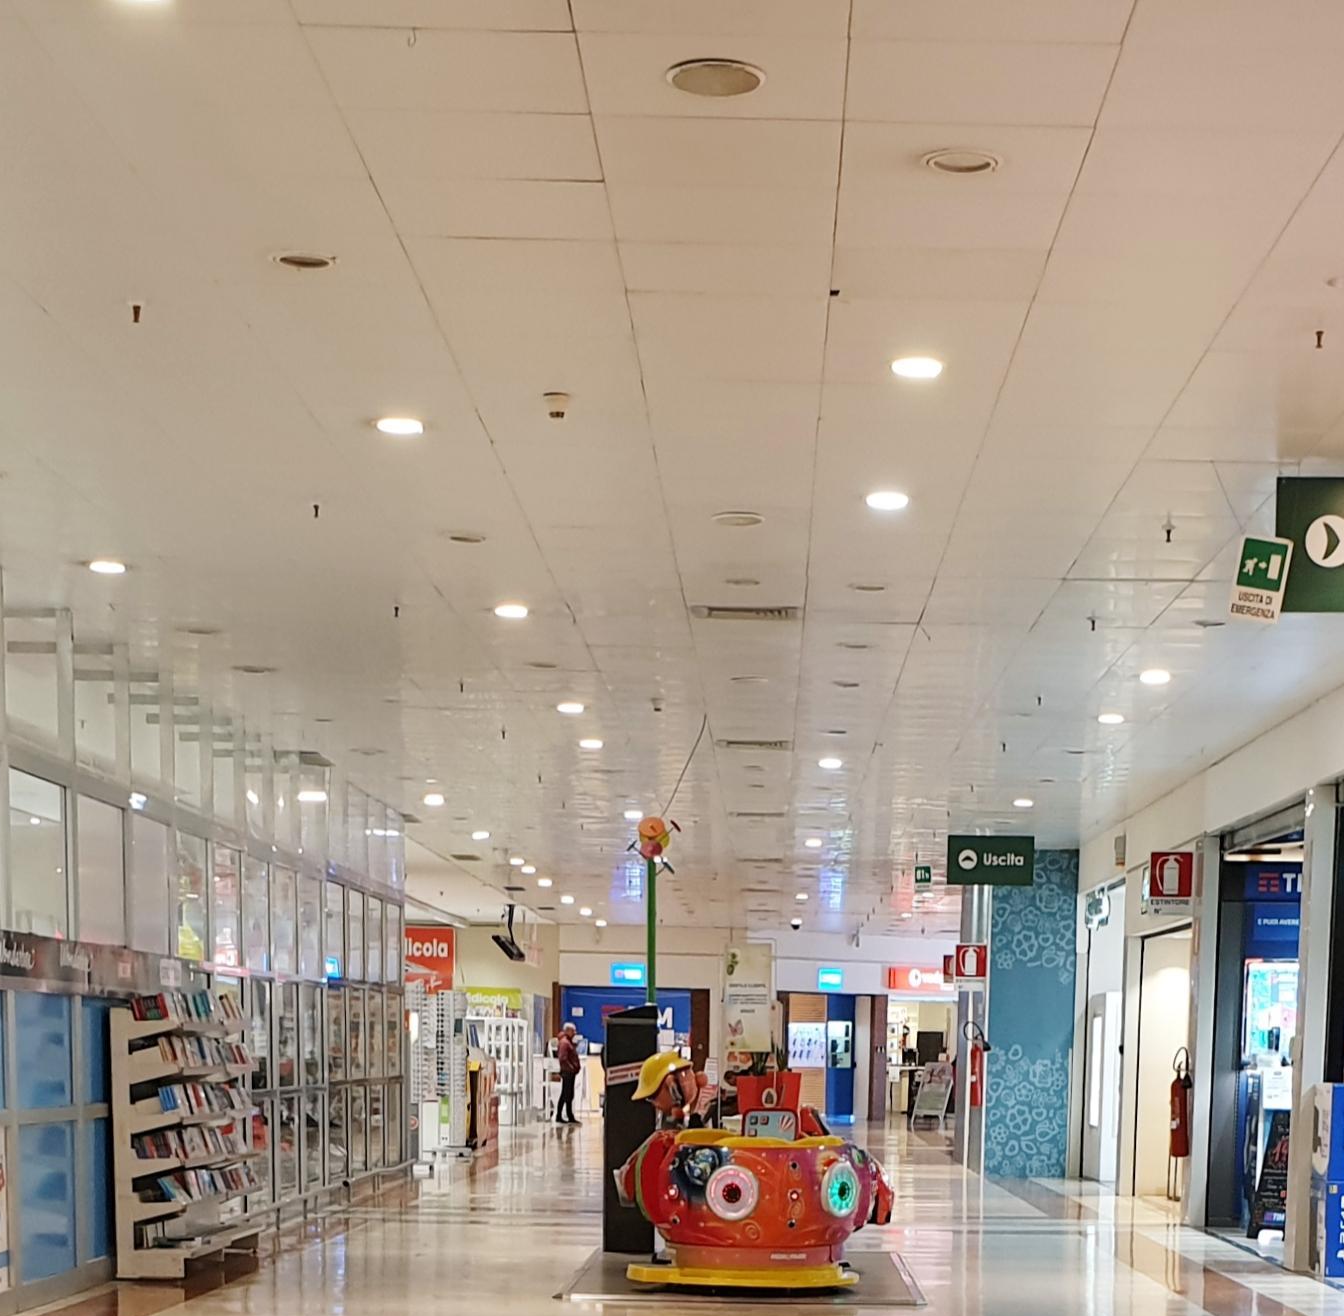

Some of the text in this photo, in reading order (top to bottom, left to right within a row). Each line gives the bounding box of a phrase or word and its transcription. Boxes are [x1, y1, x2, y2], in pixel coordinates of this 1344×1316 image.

[1238, 591, 1264, 604] USCITA
[1230, 602, 1275, 620] EMERGENZA
[982, 852, 1025, 867] Uscita
[405, 937, 449, 958] icola
